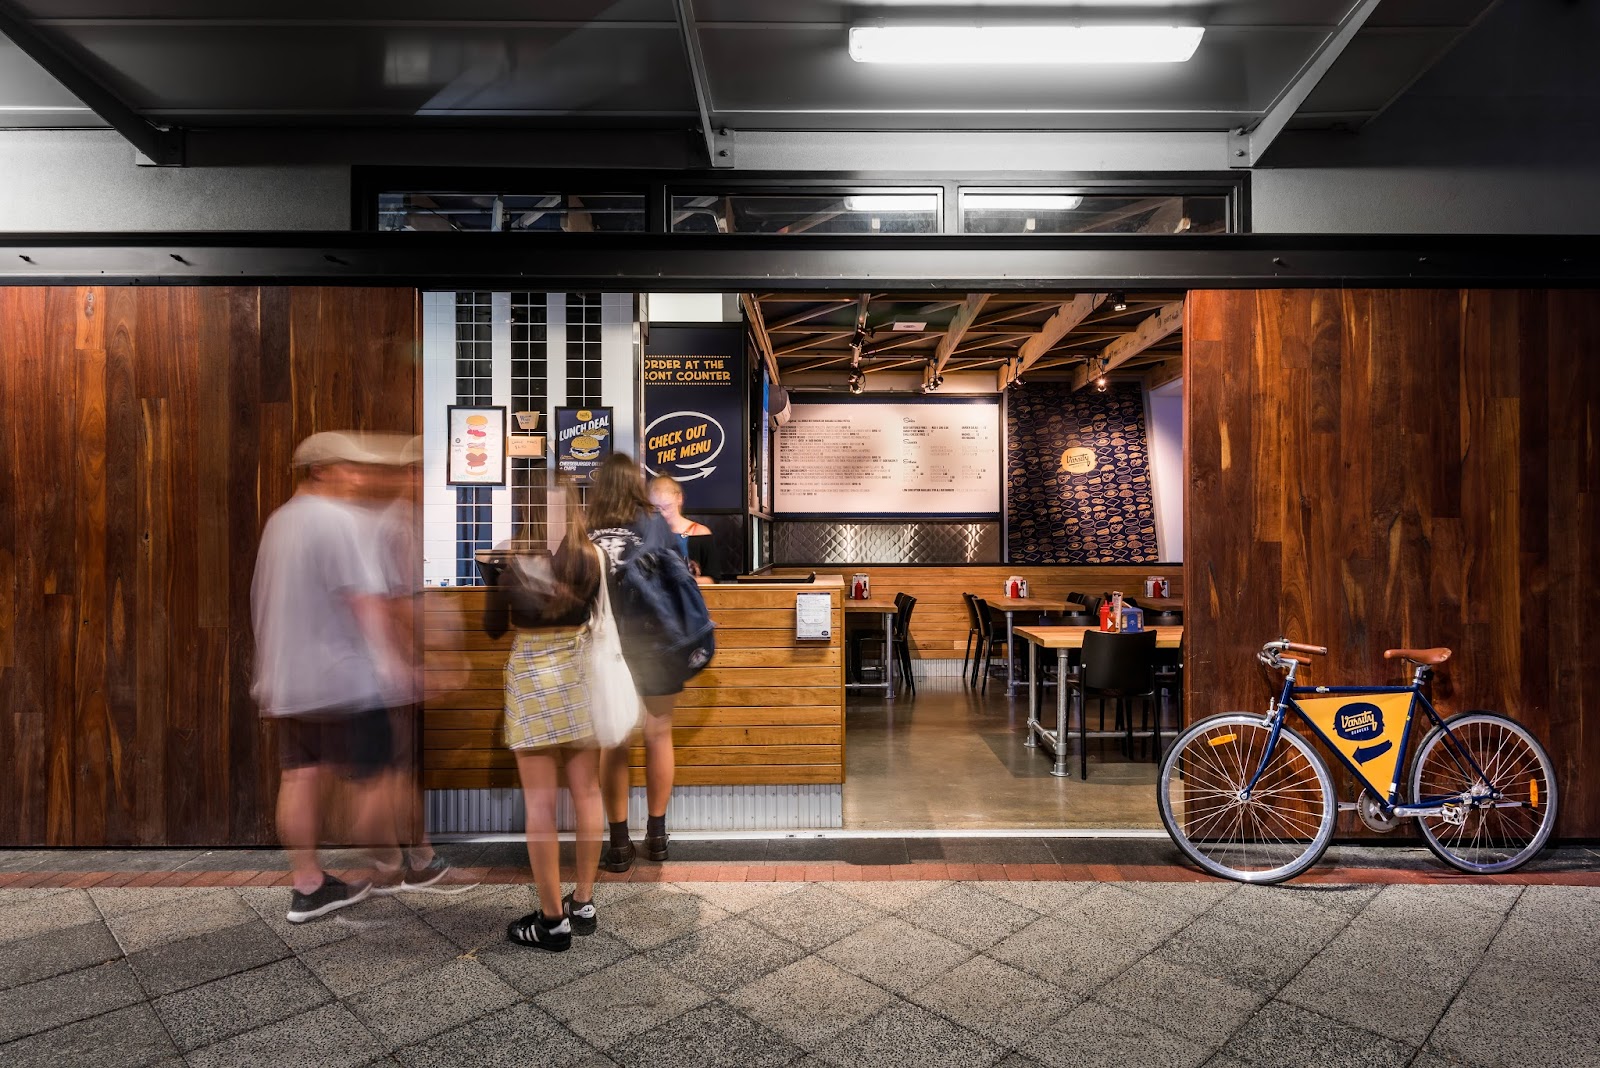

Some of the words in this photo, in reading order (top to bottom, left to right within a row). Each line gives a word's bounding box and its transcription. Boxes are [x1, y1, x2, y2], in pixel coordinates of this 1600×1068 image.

[645, 360, 681, 369] ORDER
[685, 360, 700, 369] AT
[704, 360, 724, 369] THE
[676, 371, 731, 381] COUNTER
[559, 422, 587, 442] LUNCH
[588, 415, 610, 430] DEAL
[648, 430, 683, 450] CHECK
[686, 423, 708, 440] OUT
[657, 448, 677, 464] THE
[680, 439, 712, 458] MENU
[1341, 711, 1378, 732] Varsity
